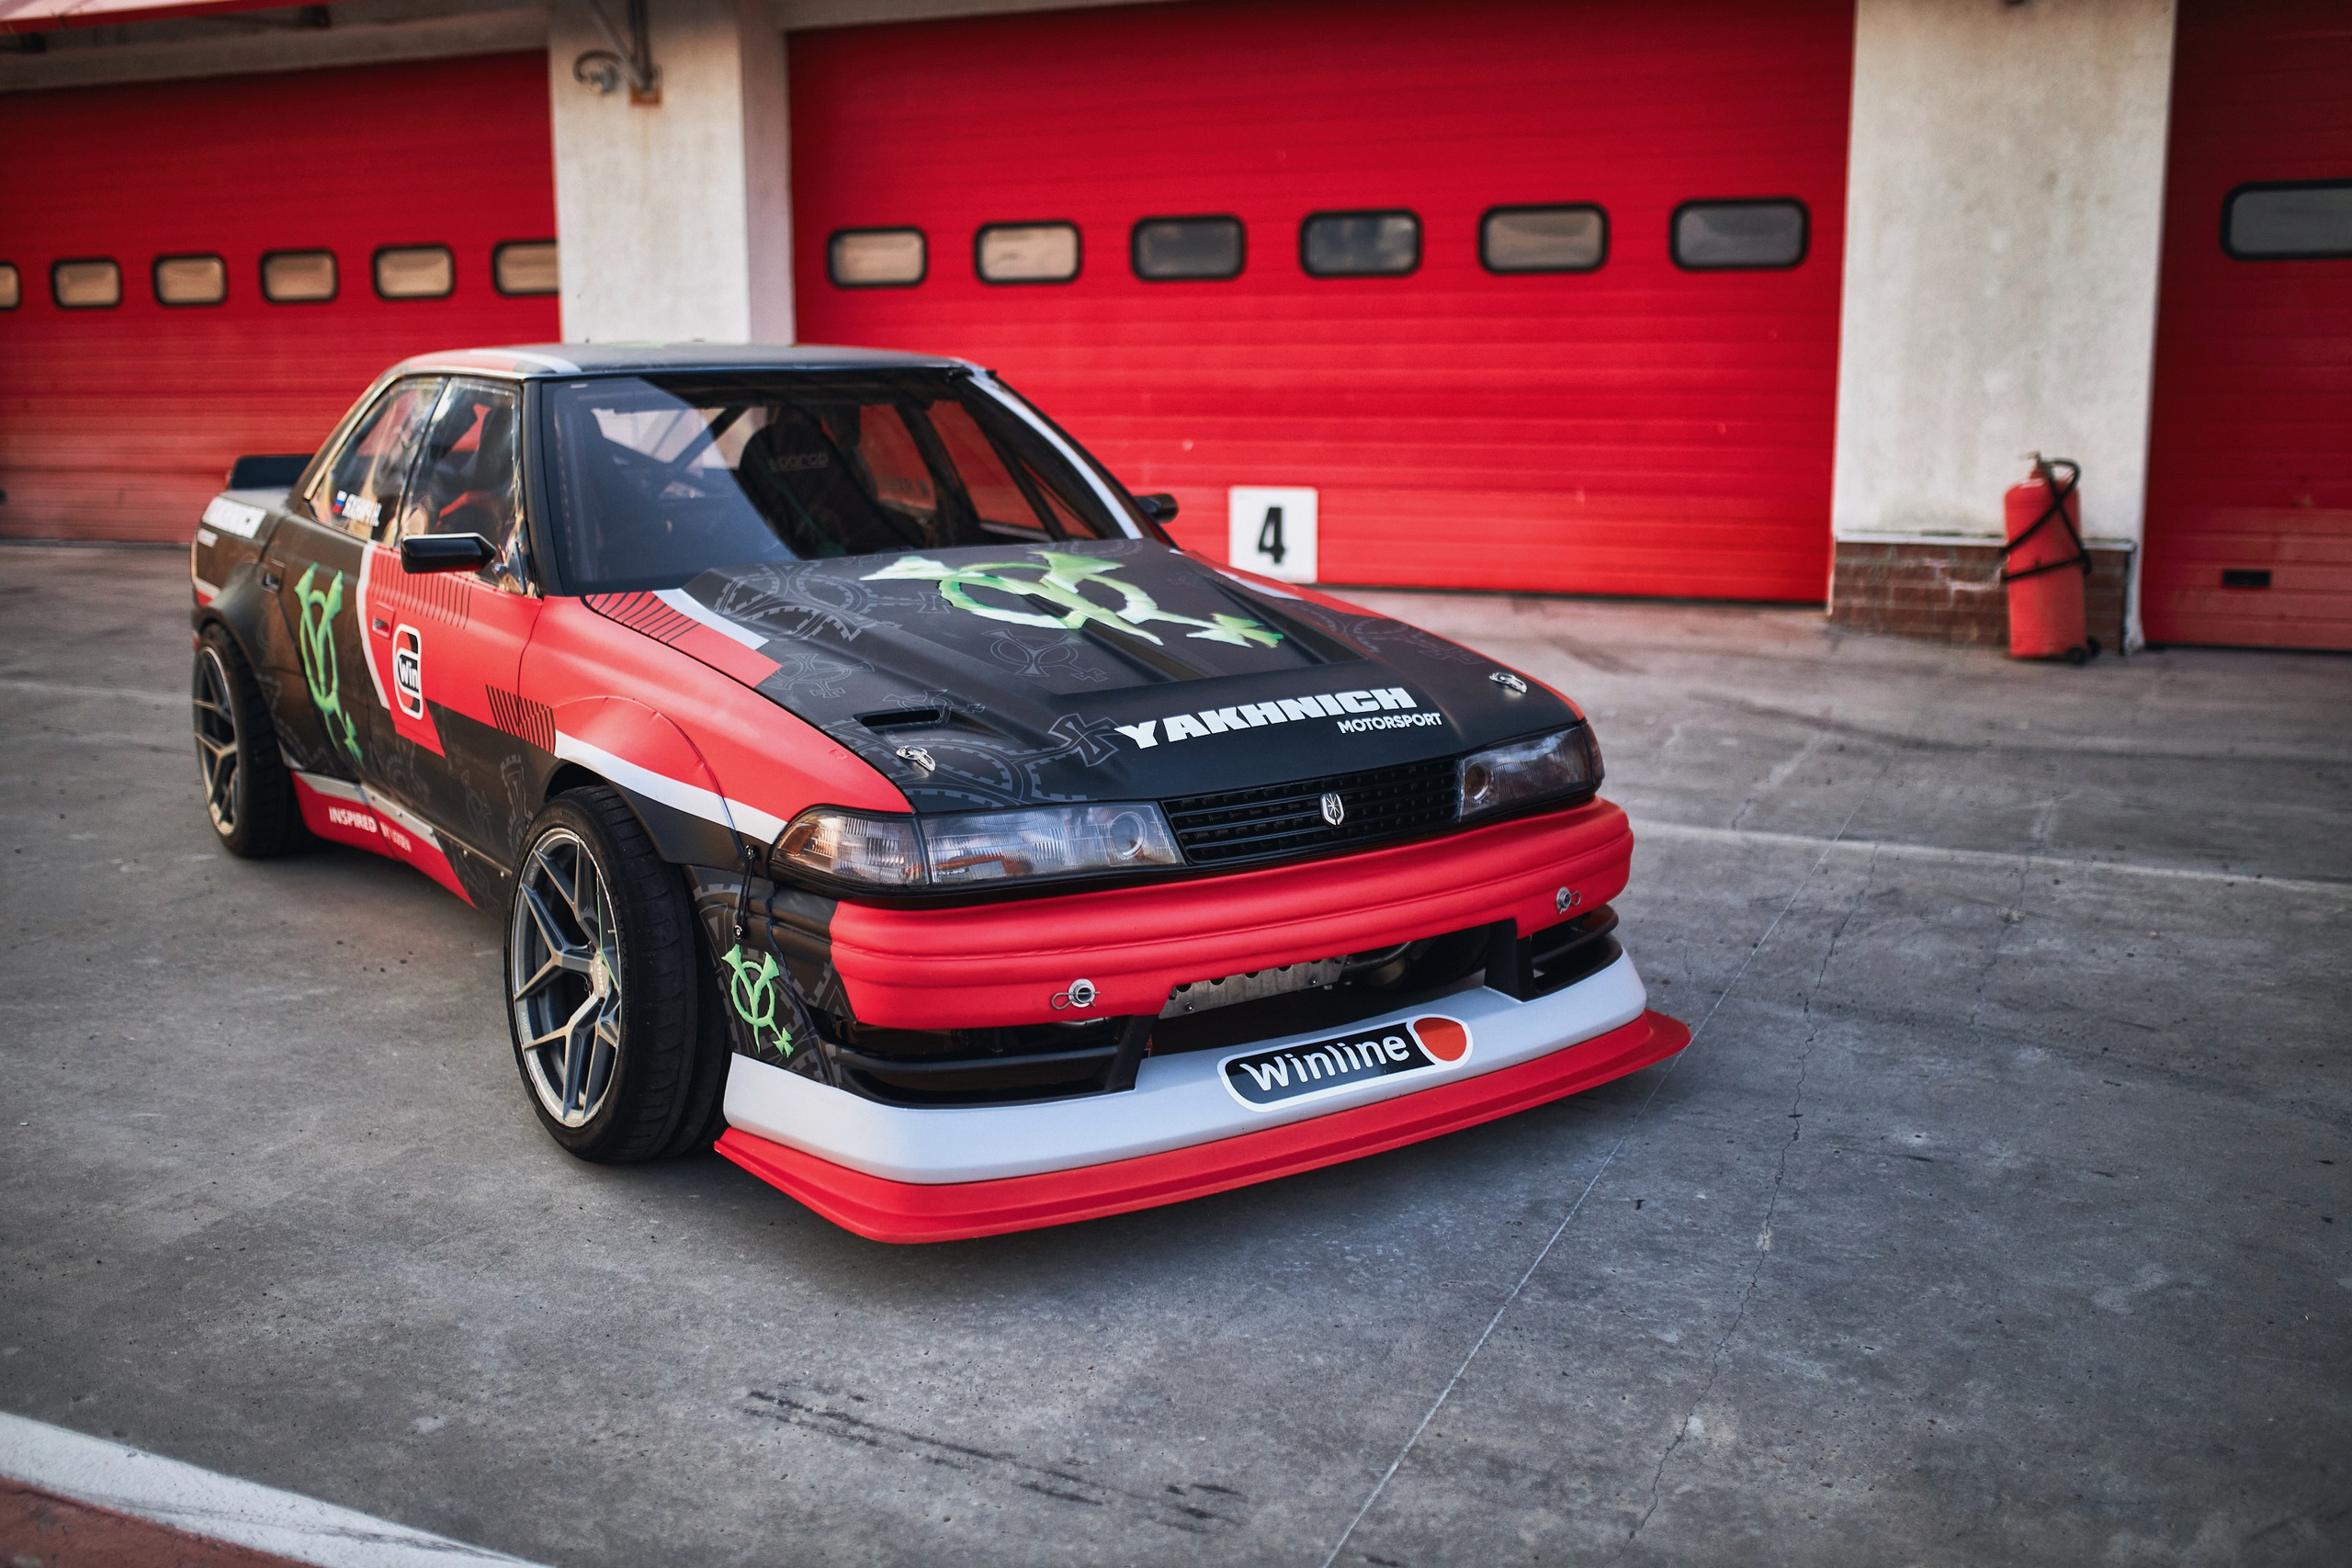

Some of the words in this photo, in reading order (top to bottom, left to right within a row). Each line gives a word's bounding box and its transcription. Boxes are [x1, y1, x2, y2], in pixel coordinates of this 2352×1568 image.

[1258, 506, 1286, 564] 4
[398, 657, 418, 690] Win
[1114, 687, 1418, 750] YAKHNICH
[1337, 713, 1442, 734] MOTORSPORT
[328, 807, 378, 833] INSPIRED
[1238, 1035, 1410, 1091] Winline
